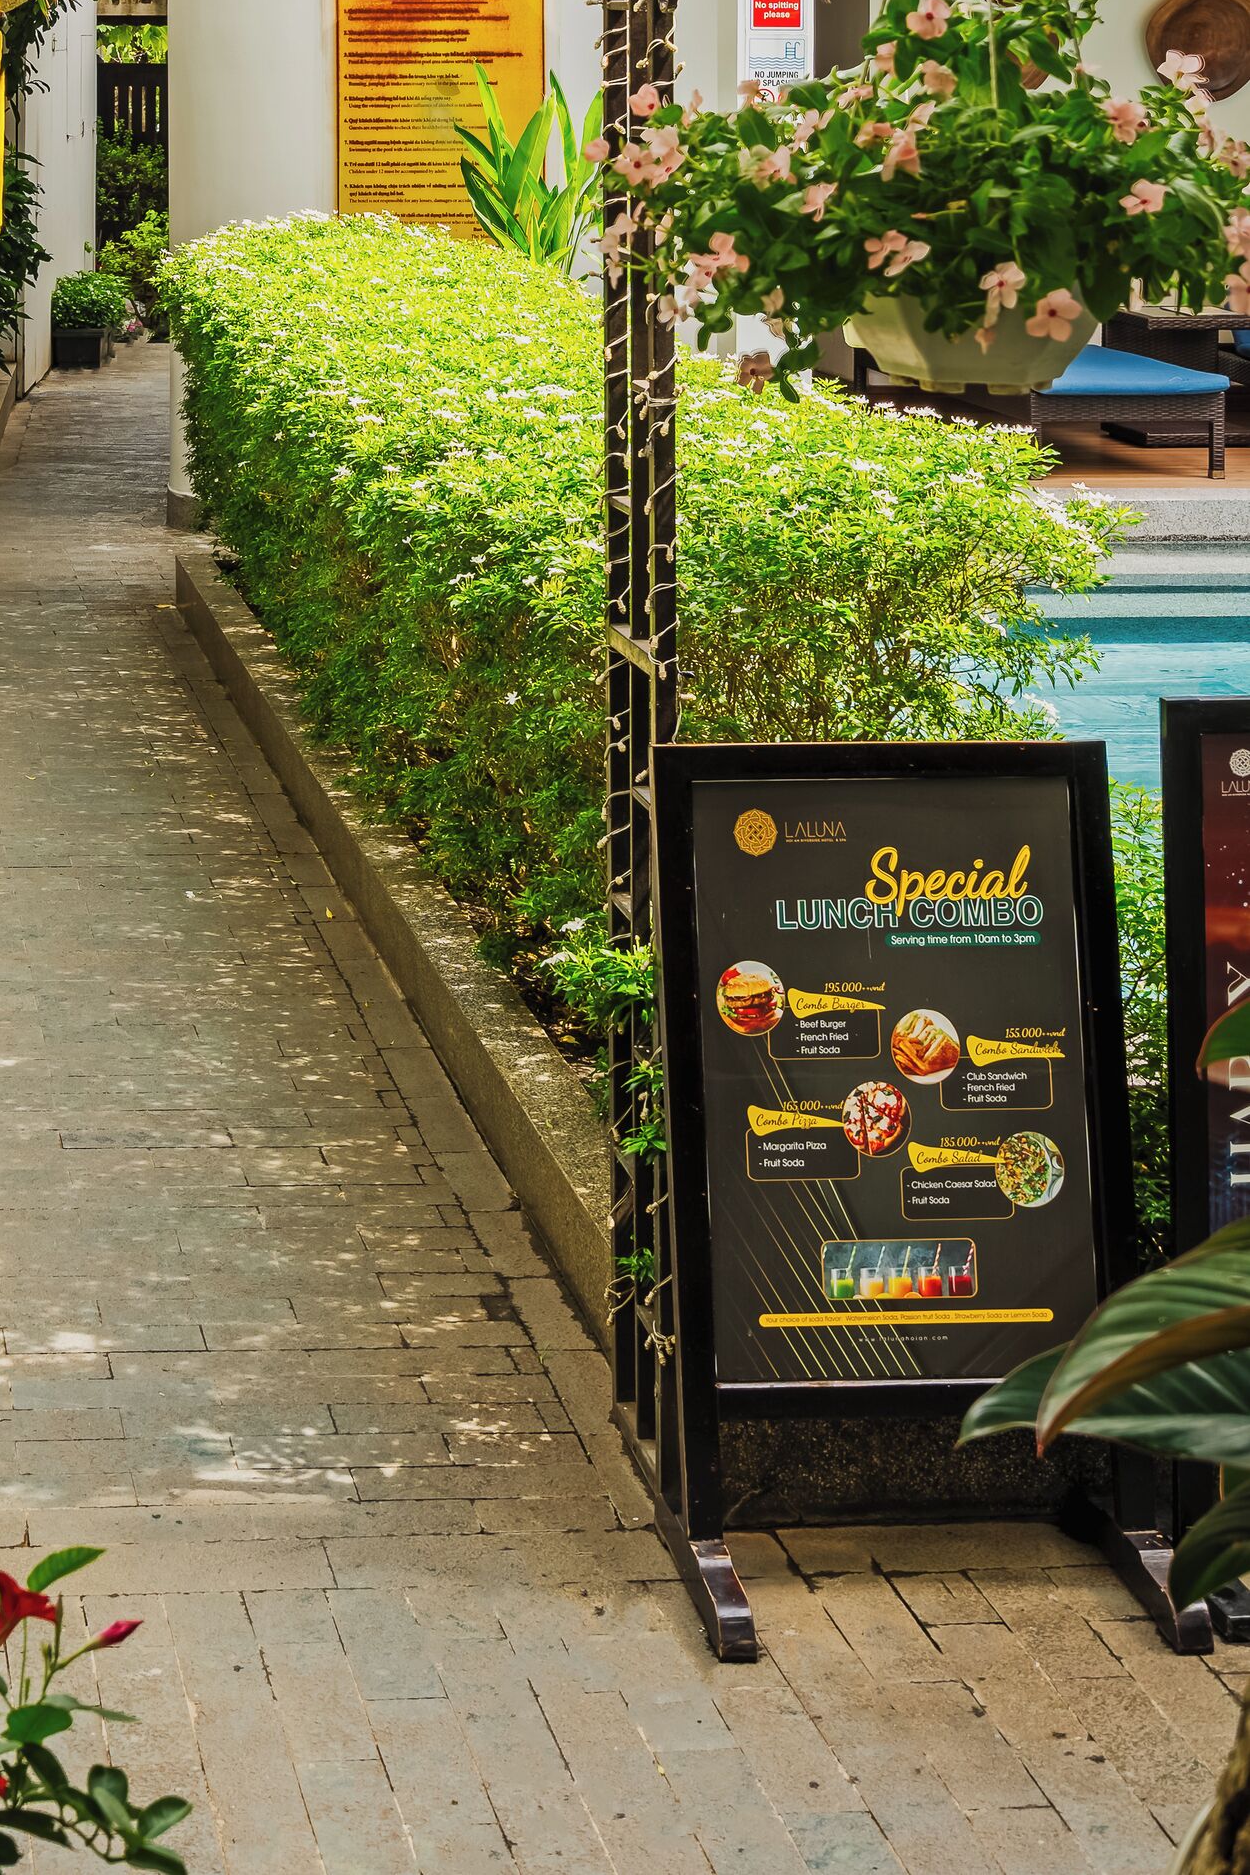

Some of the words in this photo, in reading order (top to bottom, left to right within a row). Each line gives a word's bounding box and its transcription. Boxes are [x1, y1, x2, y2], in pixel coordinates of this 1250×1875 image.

[755, 1, 766, 9] No
[768, 1, 799, 11] spitting
[763, 10, 791, 20] please
[784, 821, 847, 838] LALUNA
[865, 844, 1031, 917] Special
[775, 896, 899, 930] LUNCH
[909, 894, 1044, 928] COMBO
[891, 935, 925, 946] Serving
[927, 934, 947, 944] time
[949, 934, 971, 944] from
[974, 934, 999, 944] 10am
[1001, 934, 1011, 943] to
[1013, 933, 1036, 945] 3pm
[796, 997, 829, 1011] Combo
[831, 997, 867, 1014] Burger
[800, 1020, 819, 1029] Beef
[820, 1020, 847, 1030] Burger
[800, 1033, 828, 1042] French
[829, 1032, 849, 1041] Fried
[801, 1045, 817, 1054] Fruit
[818, 1045, 841, 1054] Soda
[975, 1042, 1007, 1055] Combo
[967, 1072, 986, 1081] Club
[987, 1071, 1028, 1080] Sandwich
[967, 1083, 995, 1092] French
[996, 1082, 1016, 1091] Fried
[967, 1094, 984, 1103] Fruit
[985, 1094, 1007, 1103] Soda
[756, 1113, 789, 1127] Combo
[792, 1113, 818, 1129] Pizza
[763, 1142, 804, 1152] Margarita
[806, 1141, 827, 1150] Pizza
[763, 1158, 781, 1167] Fruit
[782, 1158, 805, 1167] Soda
[916, 1151, 949, 1165] Combo
[951, 1150, 983, 1164] Salad
[911, 1180, 944, 1189] Chicken
[944, 1180, 973, 1188] Caesar
[974, 1179, 997, 1188] Salad
[911, 1196, 928, 1205] Fruit
[928, 1196, 950, 1204] Soda
